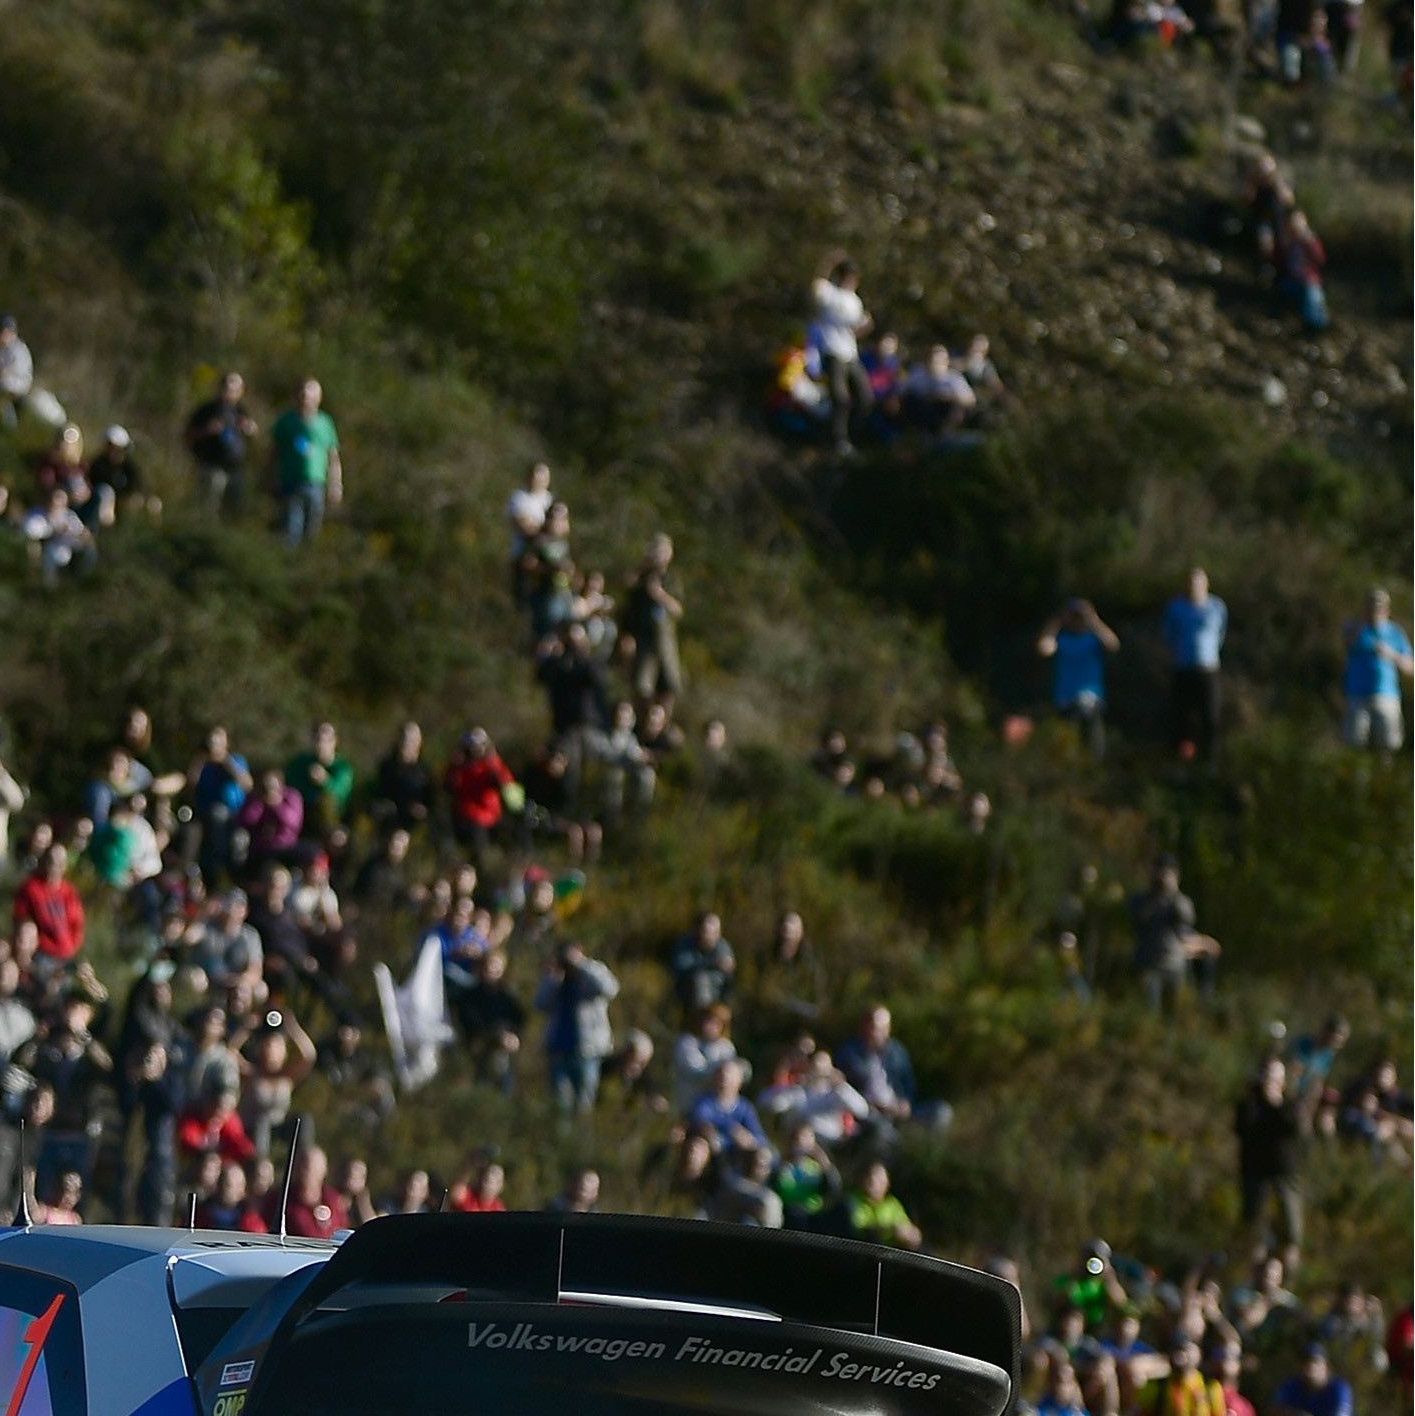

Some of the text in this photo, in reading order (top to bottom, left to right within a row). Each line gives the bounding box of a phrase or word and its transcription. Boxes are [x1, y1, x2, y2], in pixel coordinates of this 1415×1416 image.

[466, 1322, 943, 1392] Volkswagen Financial Services
